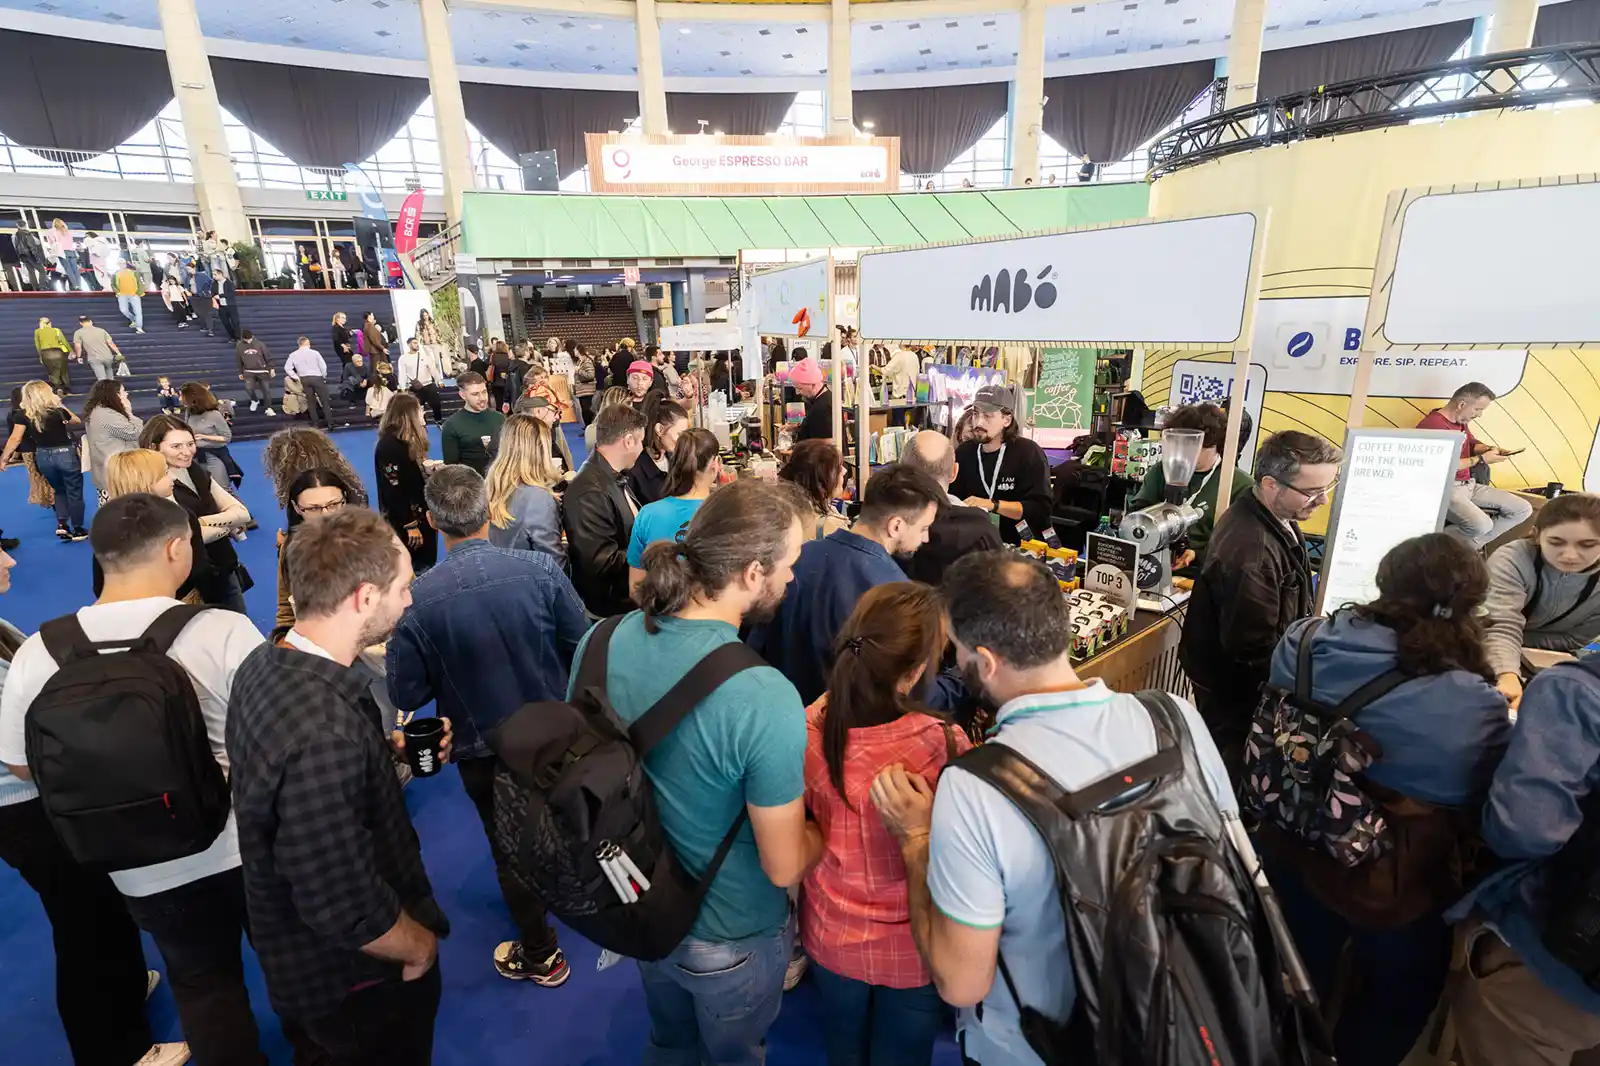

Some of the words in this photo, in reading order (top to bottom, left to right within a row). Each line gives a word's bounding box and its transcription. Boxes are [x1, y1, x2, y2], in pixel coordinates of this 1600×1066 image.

[672, 155, 717, 169] George
[719, 155, 781, 167] ESPRESSO
[784, 155, 809, 167] BAR
[311, 191, 343, 200] EXIT
[403, 216, 416, 237] BCR
[1339, 357, 1392, 367] EXPRE.
[1395, 357, 1416, 367] SIP.
[1419, 357, 1468, 367] REPEAT.
[1044, 383, 1071, 397] coffee
[1357, 442, 1394, 453] COFFEE
[1397, 443, 1444, 455] ROASTED
[1377, 456, 1395, 466] THE
[1399, 457, 1426, 468] HOME
[1353, 468, 1395, 479] BREWER
[1096, 570, 1114, 586] TOP
[1115, 576, 1123, 589] 3
